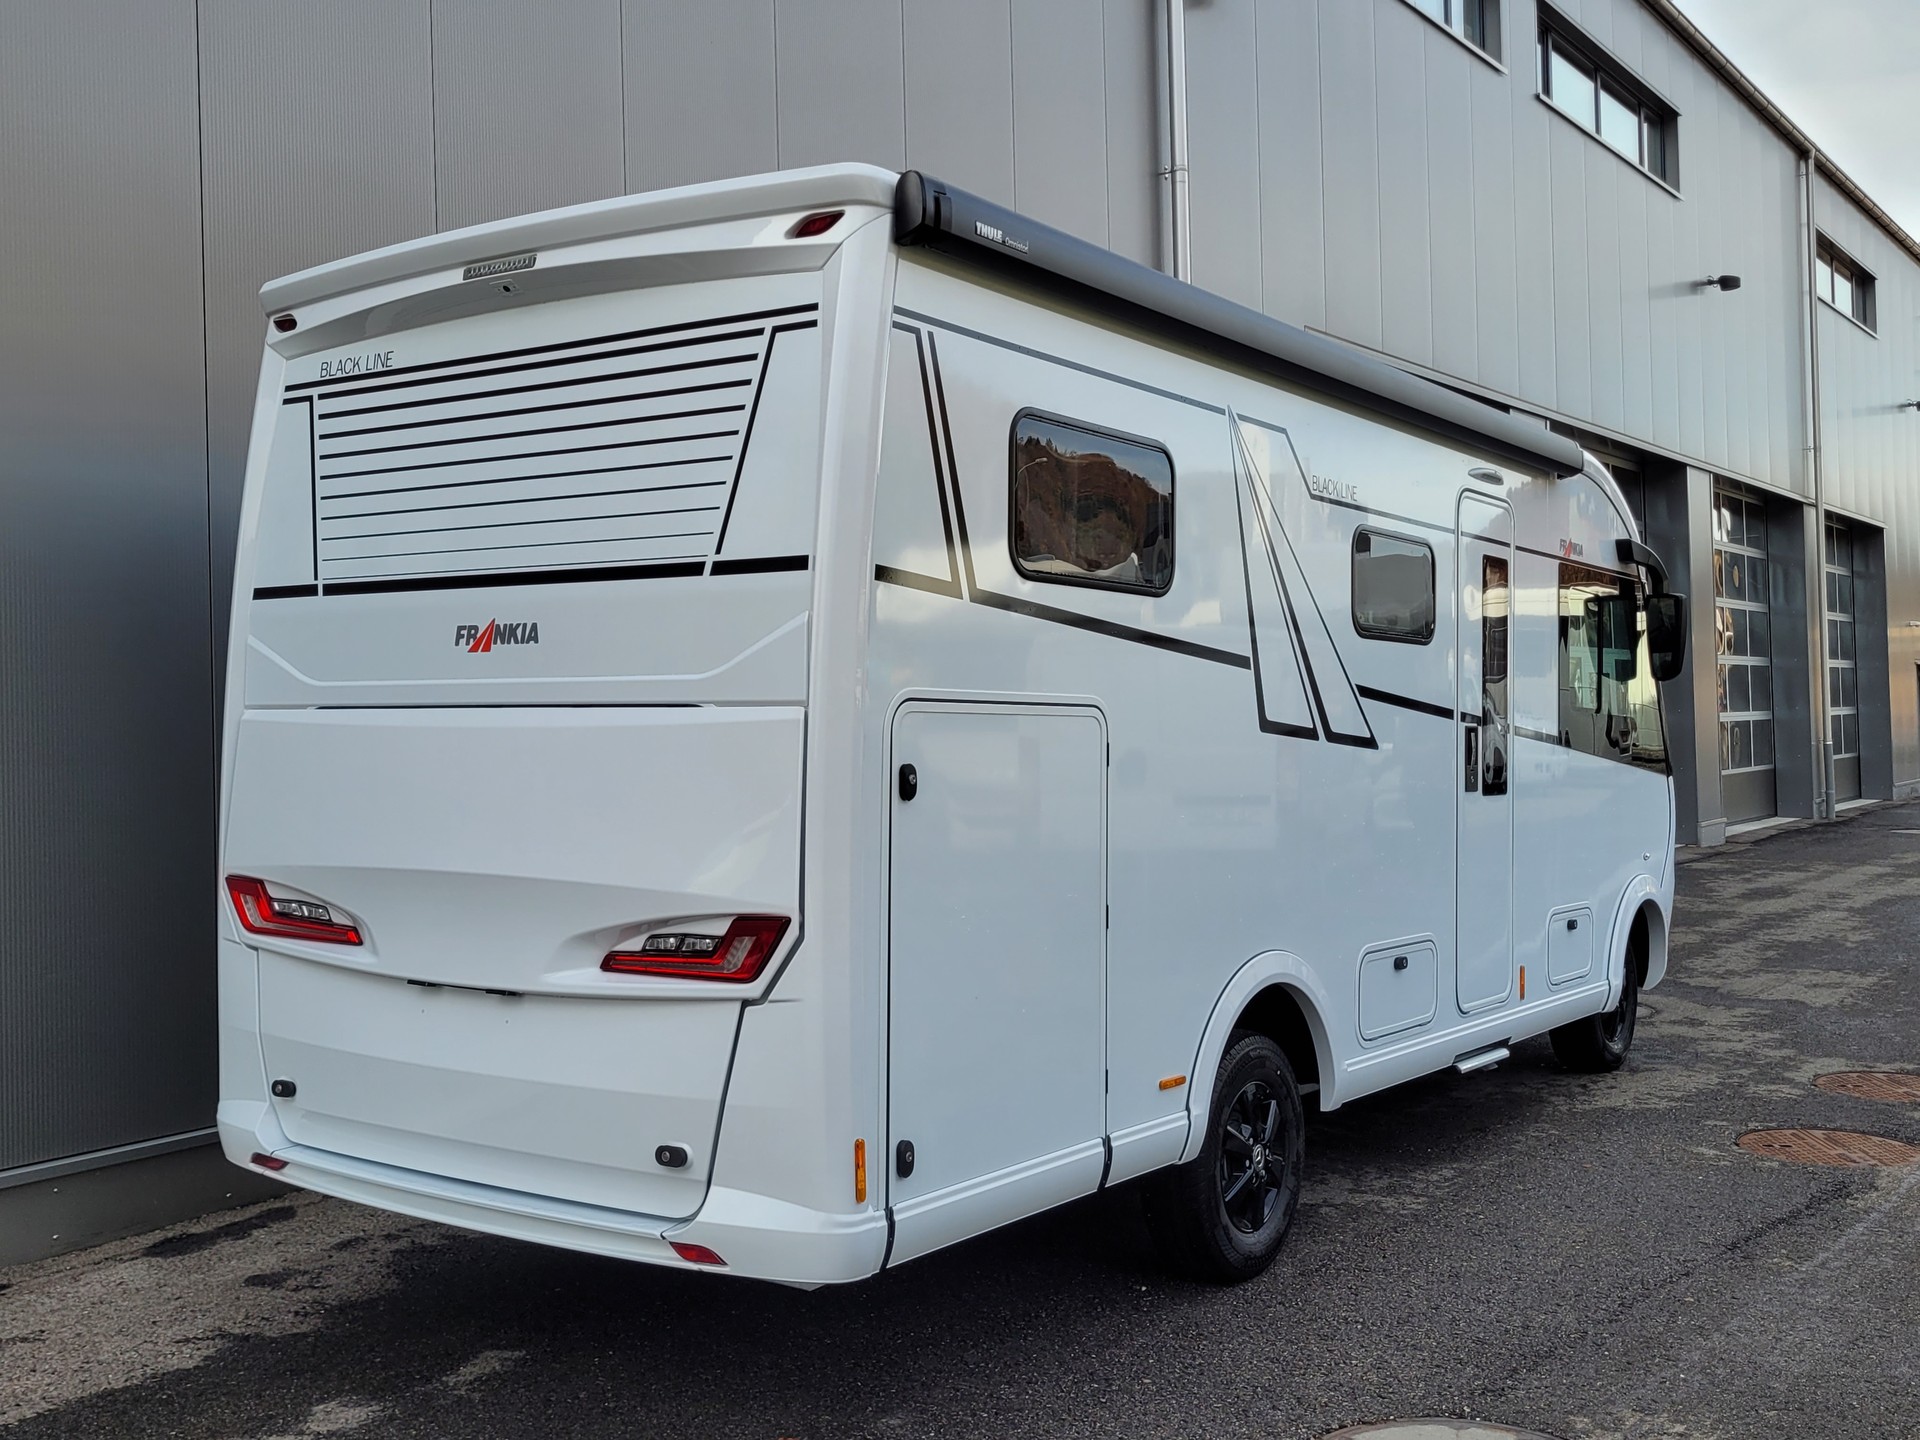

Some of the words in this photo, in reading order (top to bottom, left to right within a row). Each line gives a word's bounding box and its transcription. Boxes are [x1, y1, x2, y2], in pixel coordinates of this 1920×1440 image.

[976, 221, 1003, 243] THULE
[320, 355, 362, 378] BLACK
[365, 350, 394, 371] LINE
[1312, 474, 1339, 497] BLACK
[1340, 482, 1358, 502] LINE
[454, 618, 539, 653] FRANKIA
